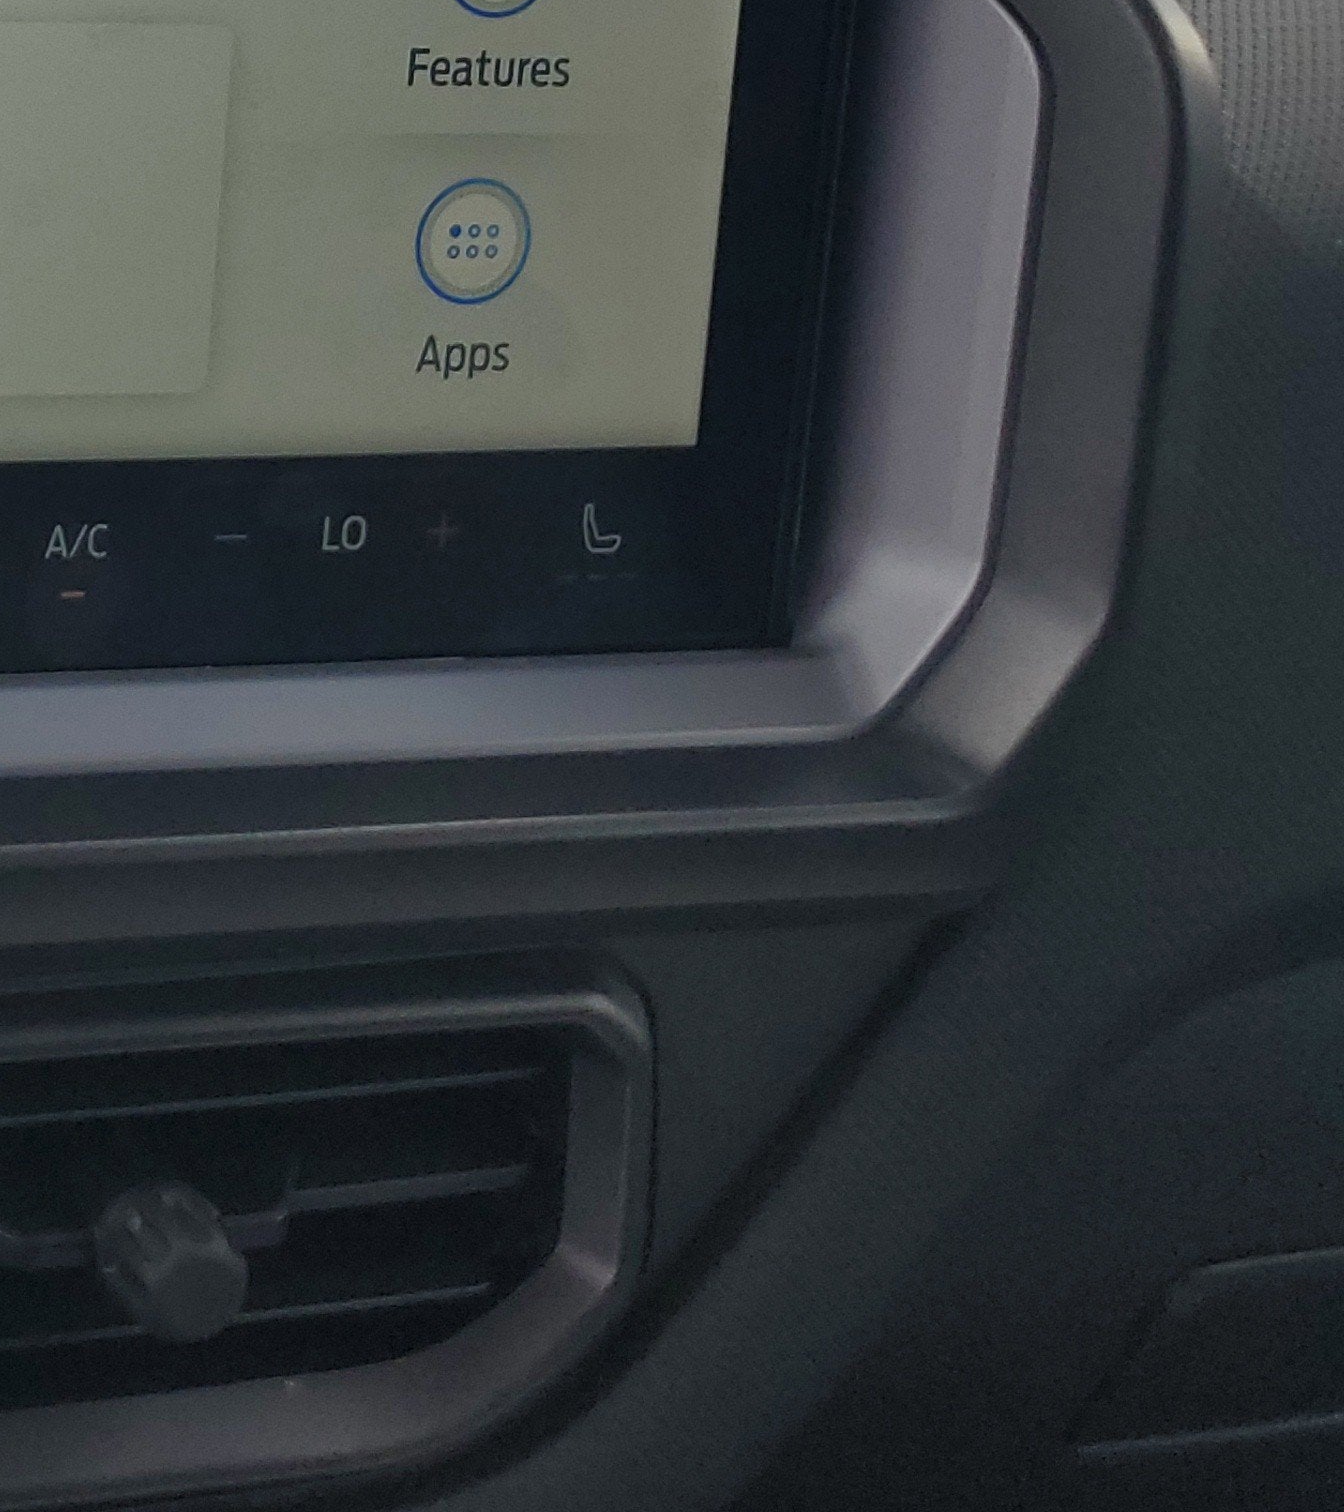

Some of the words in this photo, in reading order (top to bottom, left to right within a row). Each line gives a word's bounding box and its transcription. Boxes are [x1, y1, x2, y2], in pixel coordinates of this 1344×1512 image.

[407, 48, 571, 88] Features
[415, 335, 510, 379] Apps
[45, 524, 108, 560] A/C
[322, 515, 367, 551] LO
